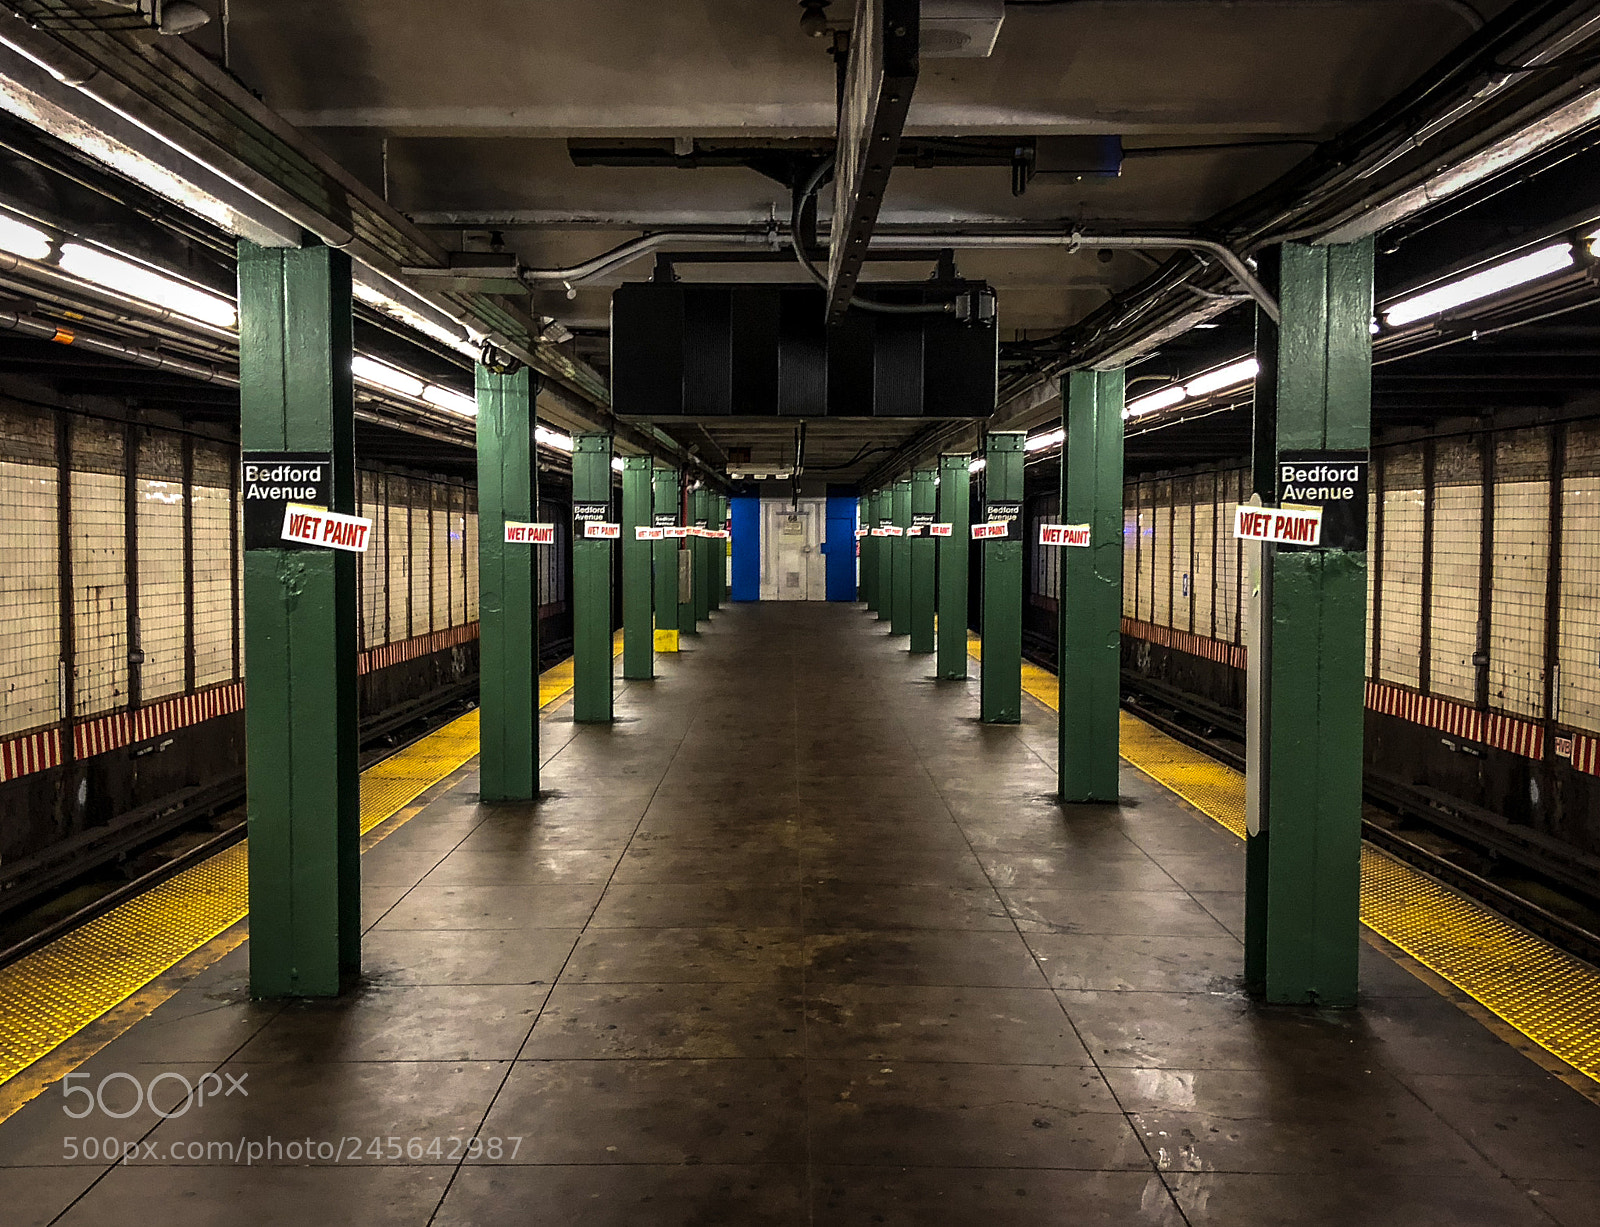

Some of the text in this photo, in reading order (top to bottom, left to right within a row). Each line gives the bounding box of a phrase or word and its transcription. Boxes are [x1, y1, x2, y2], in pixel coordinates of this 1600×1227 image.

[246, 466, 321, 482] Bedford
[1282, 466, 1359, 482] Bedford
[247, 484, 317, 500] Avenue
[1282, 484, 1354, 500] Avenue
[575, 506, 606, 514] Bedford
[575, 513, 604, 521] Avenue
[987, 506, 1020, 514] Bedford
[988, 513, 1018, 521] Avenue
[289, 513, 368, 548] WET PAINT
[507, 527, 554, 542] WET PAINT
[587, 526, 619, 536] WET PAINT
[973, 525, 1006, 537] WET PAINT
[1240, 512, 1318, 542] WET PAINT
[1043, 526, 1089, 544] WET PAINT
